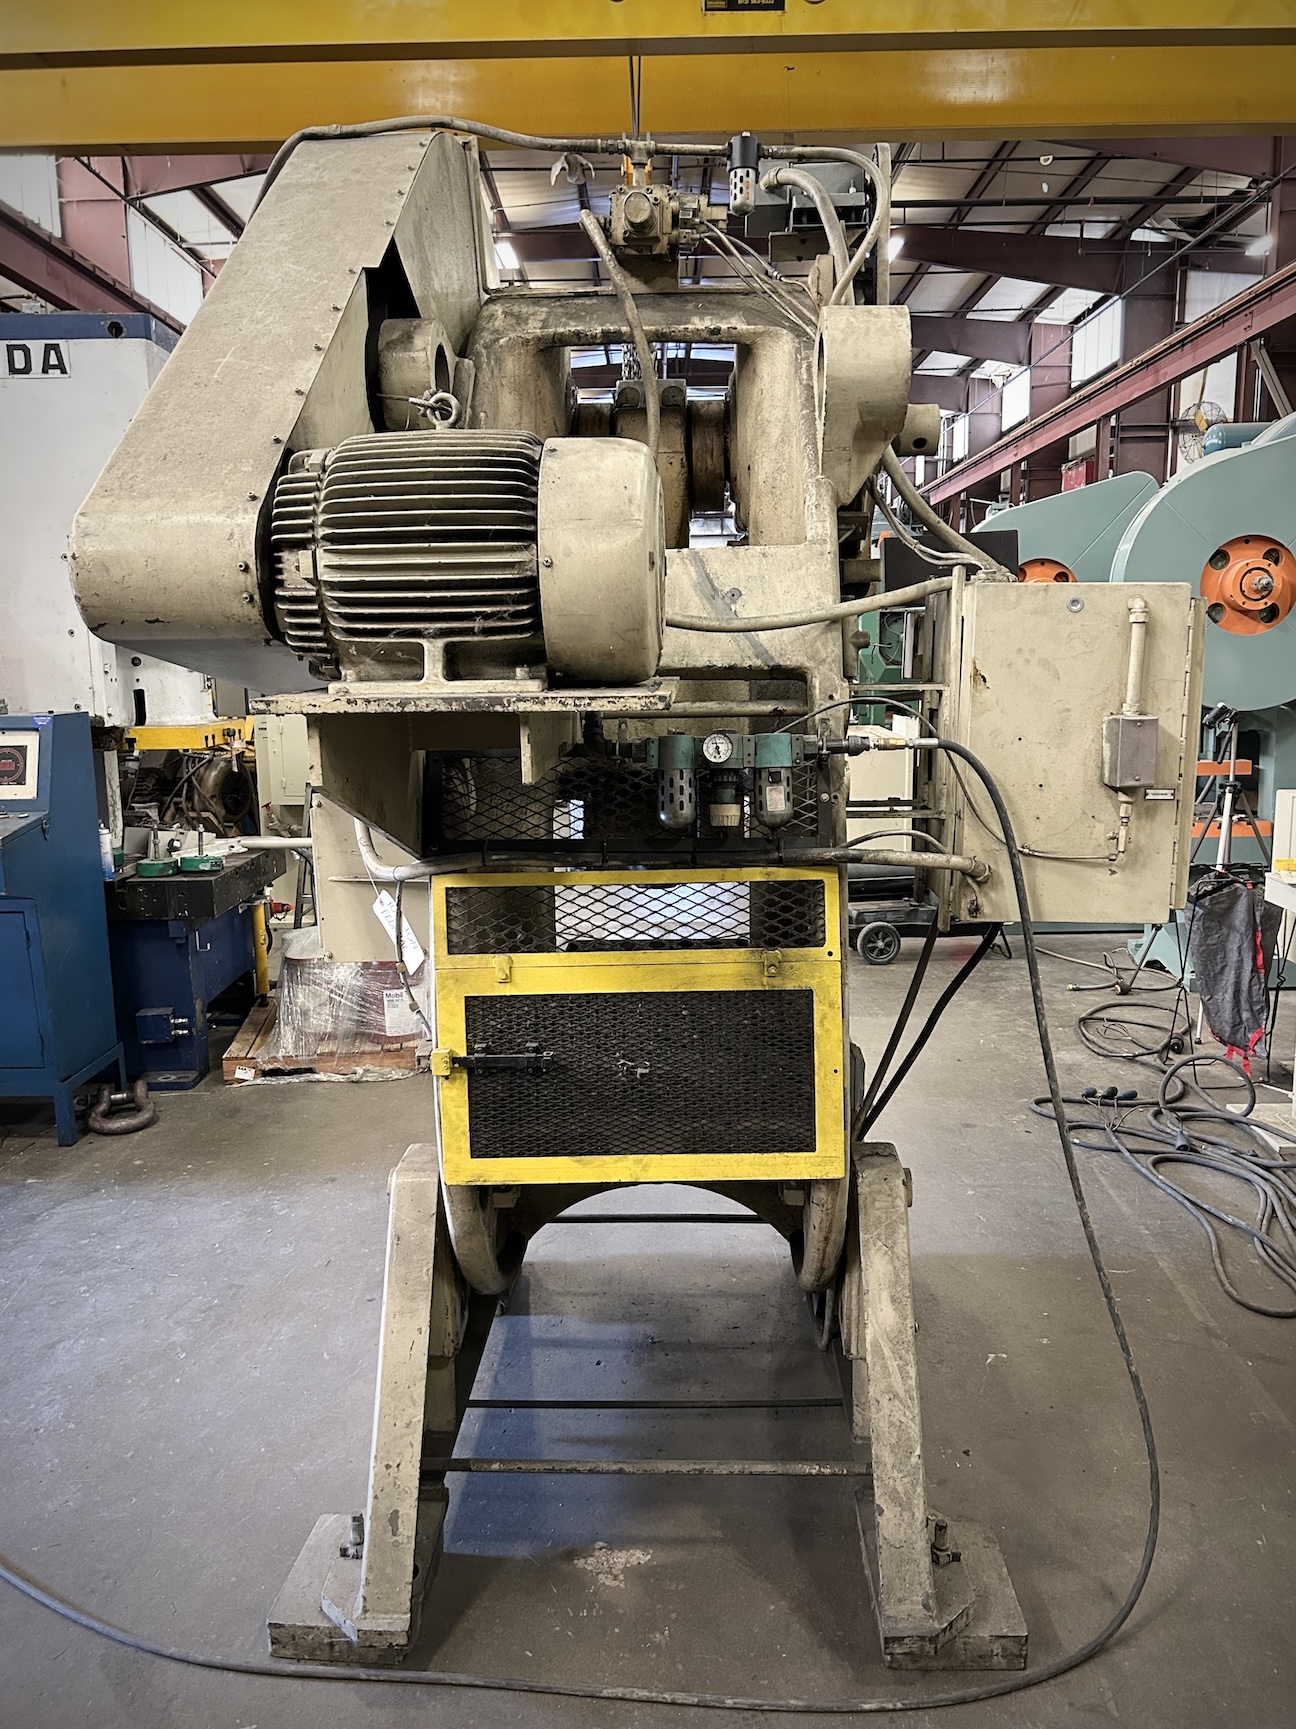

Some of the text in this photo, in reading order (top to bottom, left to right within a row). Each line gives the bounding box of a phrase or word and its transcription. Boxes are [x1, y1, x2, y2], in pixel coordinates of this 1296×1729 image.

[6, 343, 68, 375] DA
[404, 927, 419, 950] TON
[385, 991, 404, 999] Mobil
